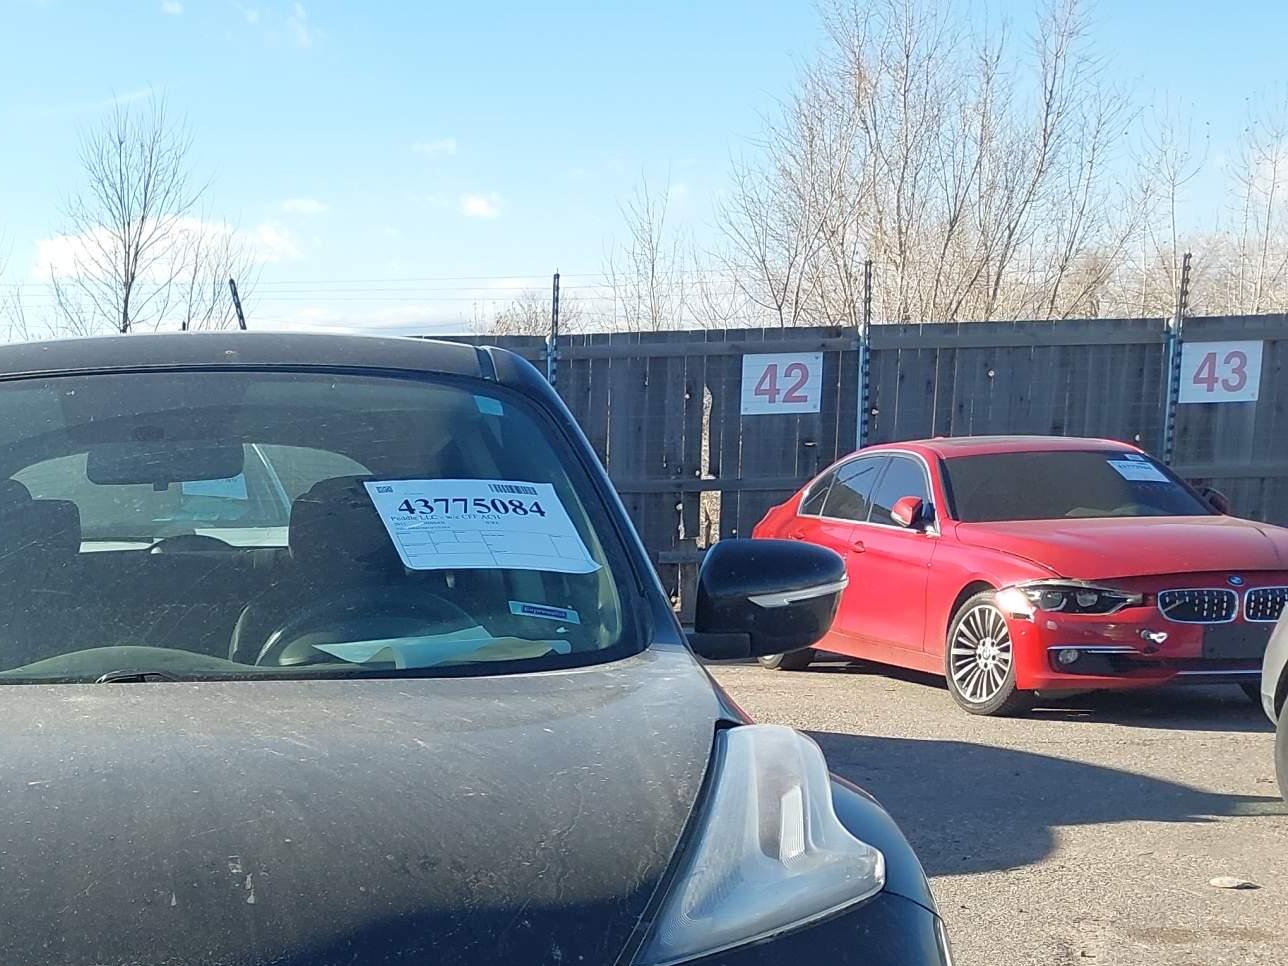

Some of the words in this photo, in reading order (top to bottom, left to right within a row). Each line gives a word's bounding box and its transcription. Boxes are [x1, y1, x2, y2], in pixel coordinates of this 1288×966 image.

[754, 363, 808, 403] 42
[1193, 351, 1247, 392] 43
[398, 498, 545, 517] 43775084
